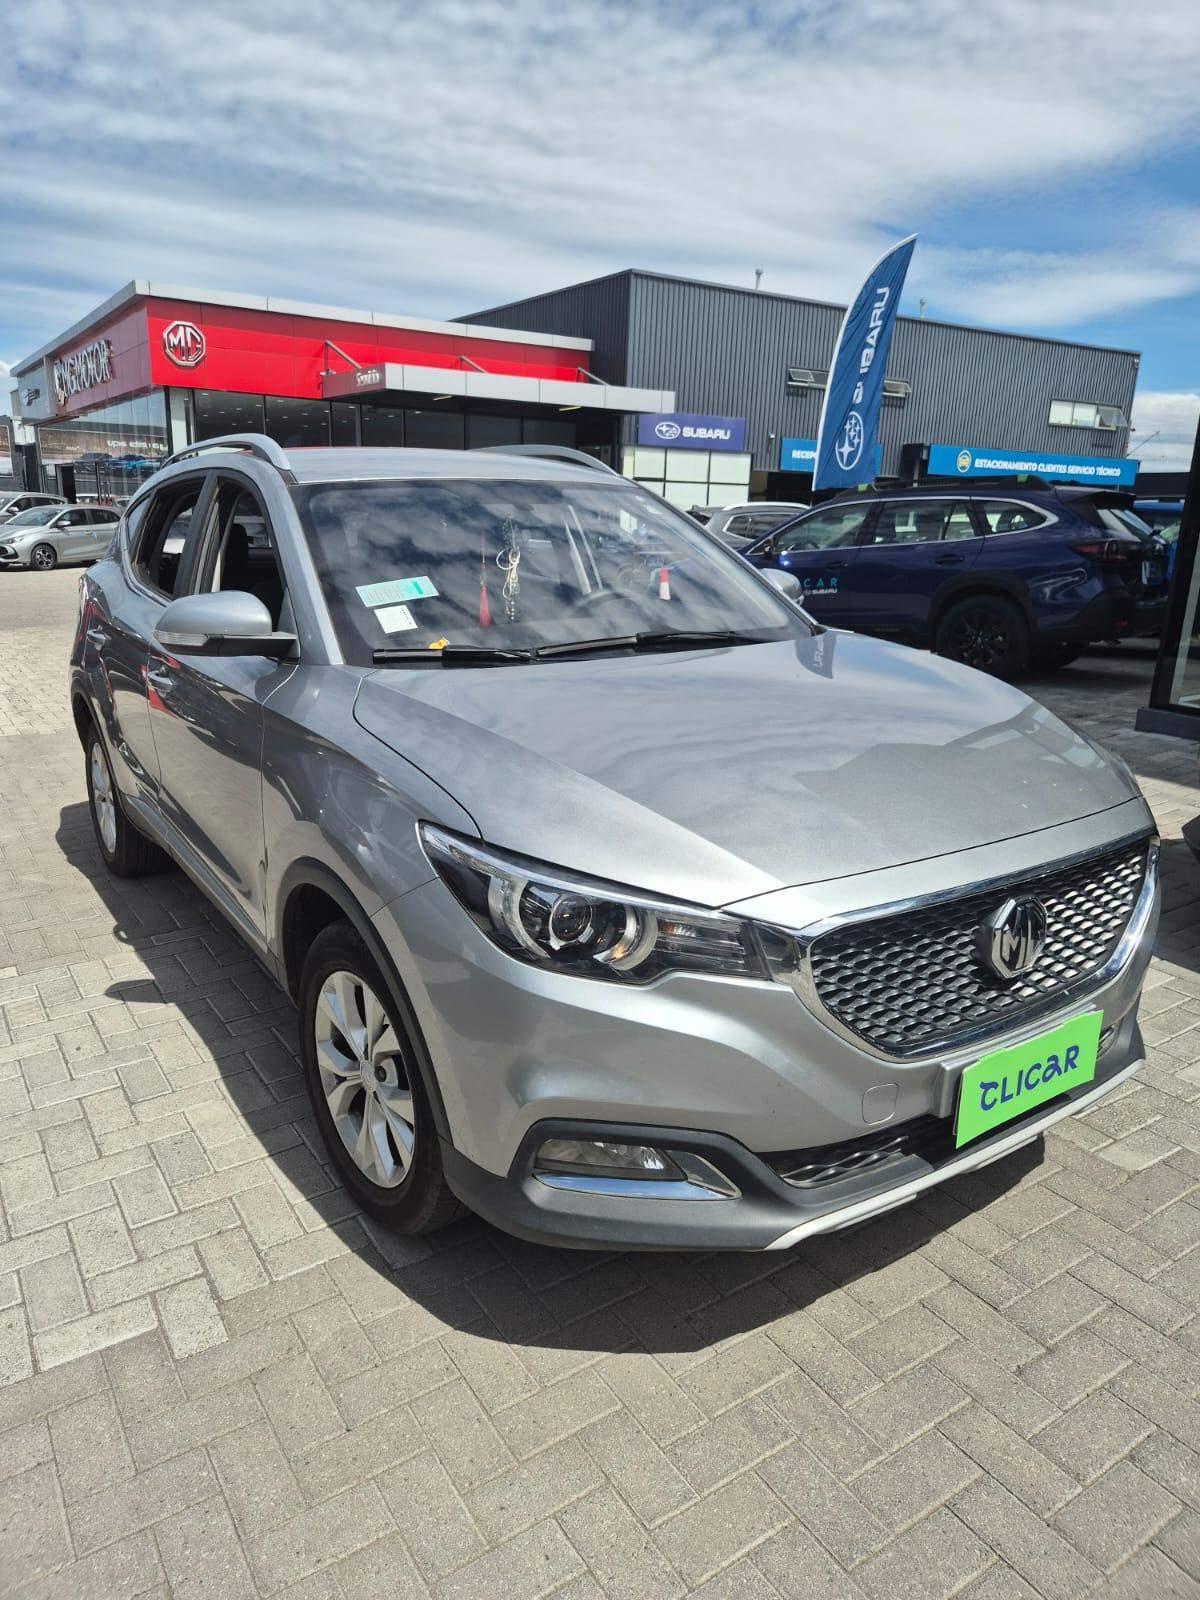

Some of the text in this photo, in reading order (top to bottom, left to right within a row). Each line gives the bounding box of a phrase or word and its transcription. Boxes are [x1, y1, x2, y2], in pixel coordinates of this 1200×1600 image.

[167, 324, 203, 362] MG
[682, 426, 731, 440] SUBARU
[974, 458, 1121, 477] ESTACIONAMIENTO CLIENTES SERVICIO TÉCNICO
